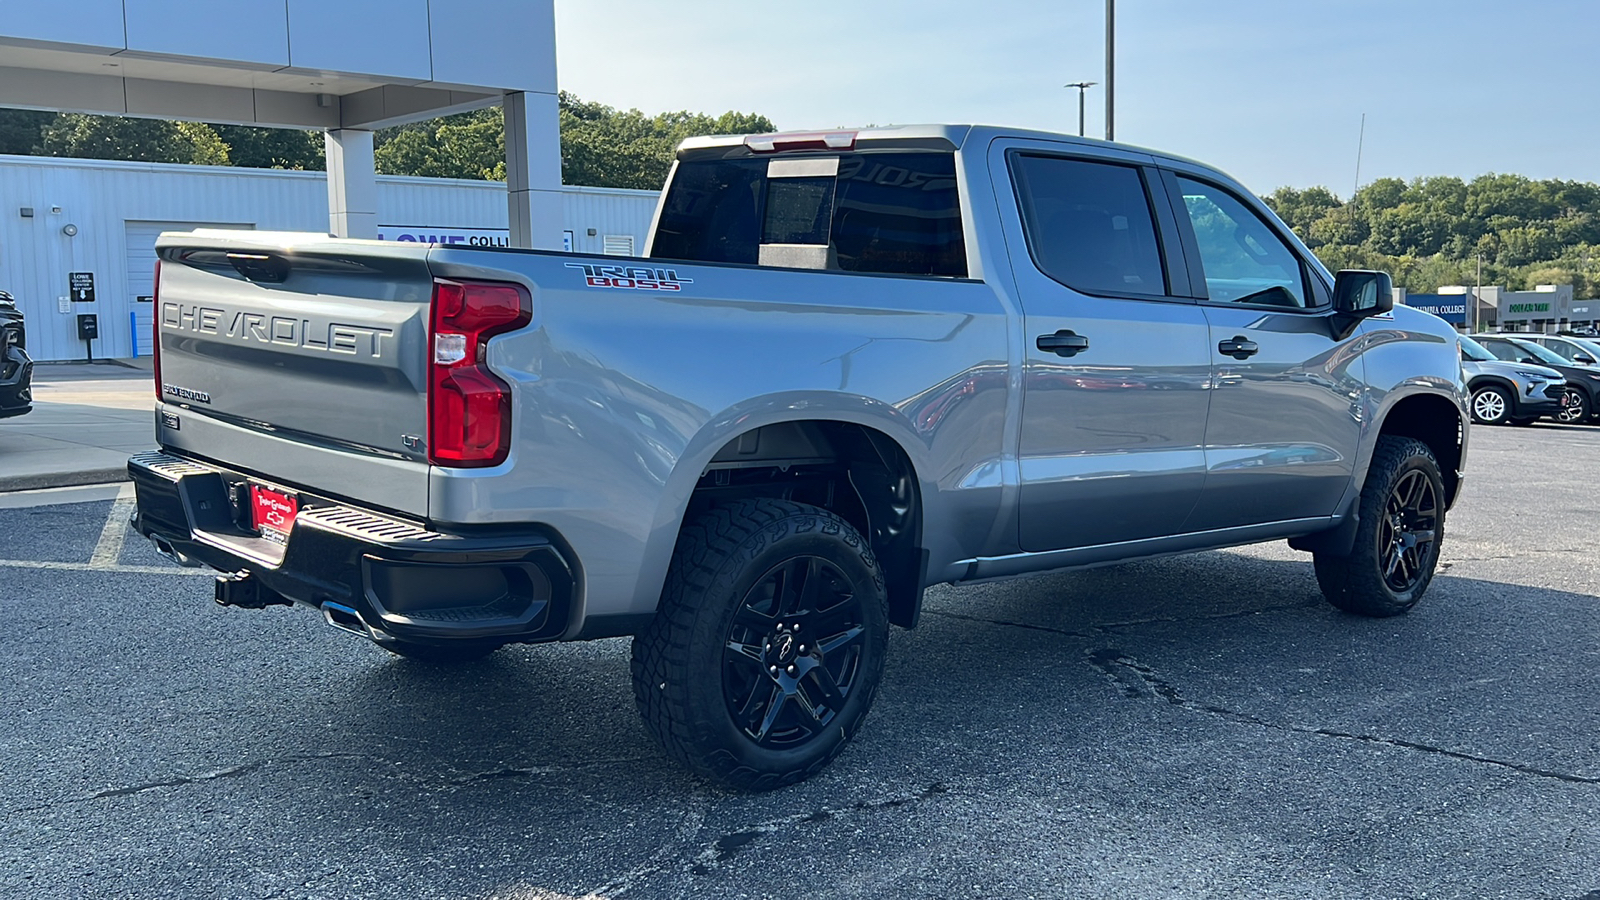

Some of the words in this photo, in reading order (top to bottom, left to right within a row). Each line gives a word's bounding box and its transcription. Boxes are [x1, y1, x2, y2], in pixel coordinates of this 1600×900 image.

[564, 262, 693, 283] TRAIL
[586, 276, 681, 291] BOSS
[1440, 305, 1465, 314] COLLEGE
[163, 302, 393, 358] CHEVROLET
